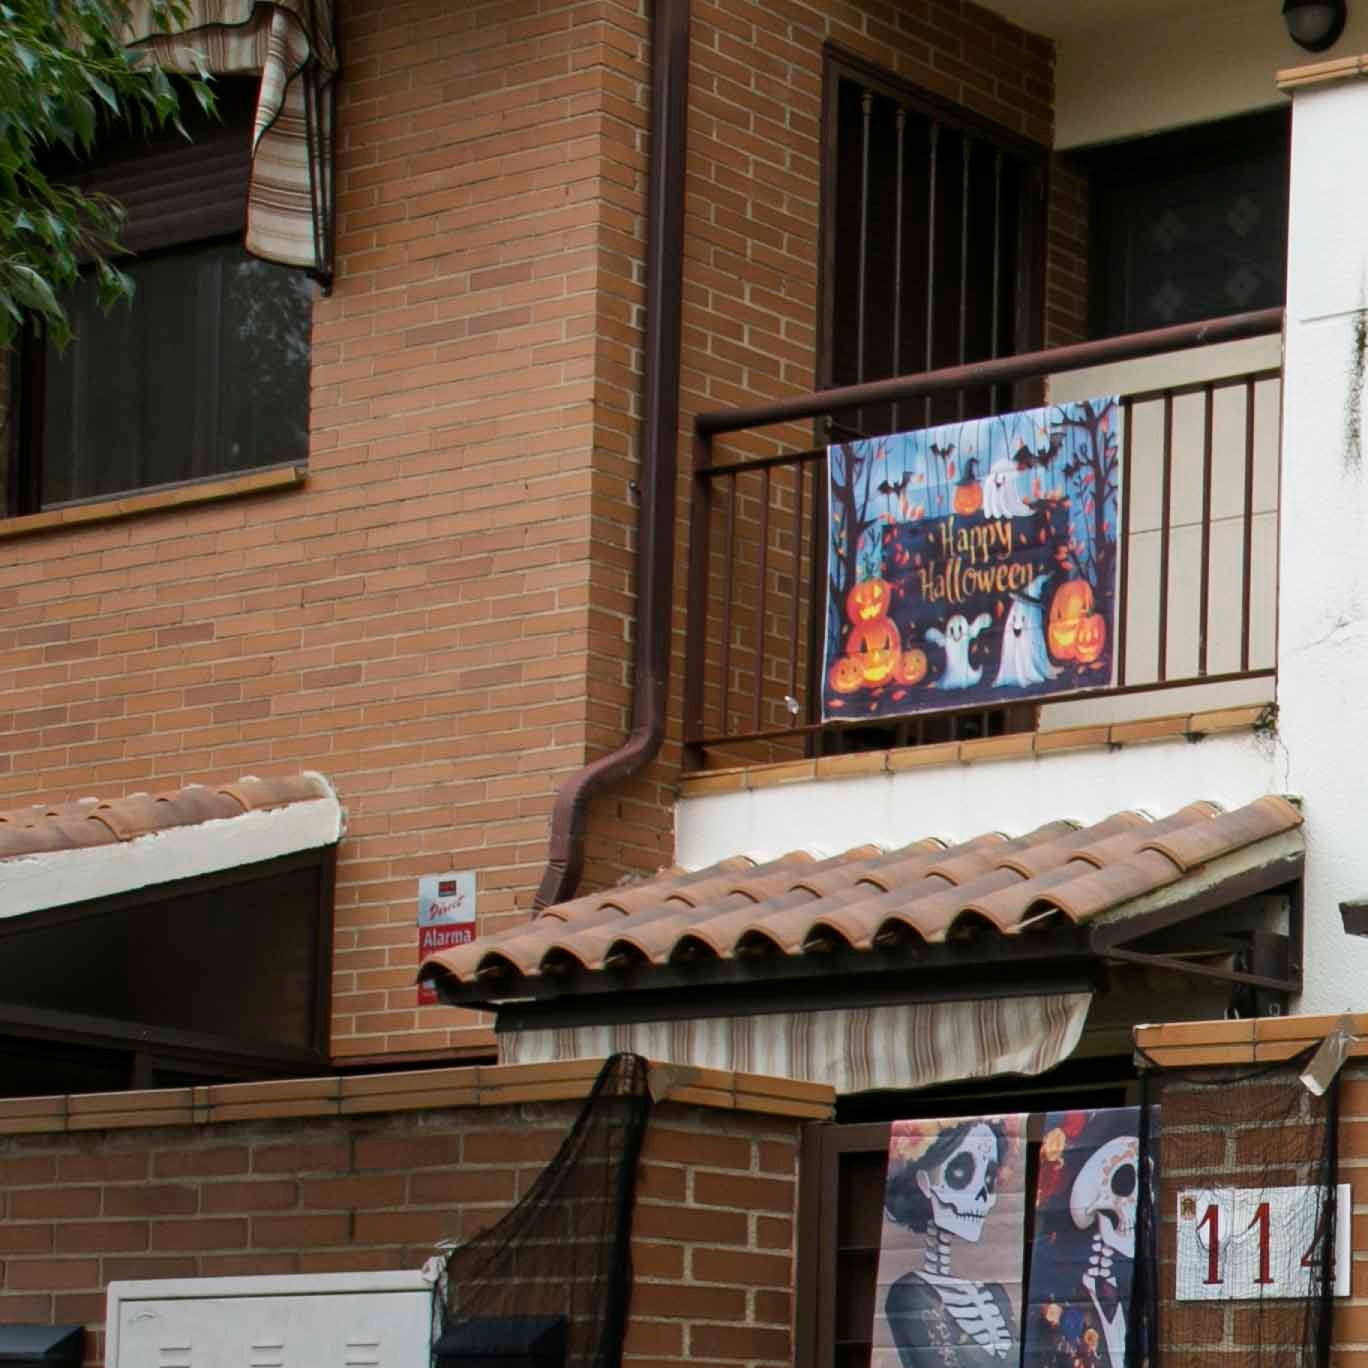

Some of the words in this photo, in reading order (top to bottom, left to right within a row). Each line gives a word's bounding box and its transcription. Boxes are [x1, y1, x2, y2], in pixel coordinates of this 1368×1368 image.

[939, 515, 1012, 564] Happy
[918, 556, 1033, 605] Halloween
[423, 928, 472, 948] Alarma
